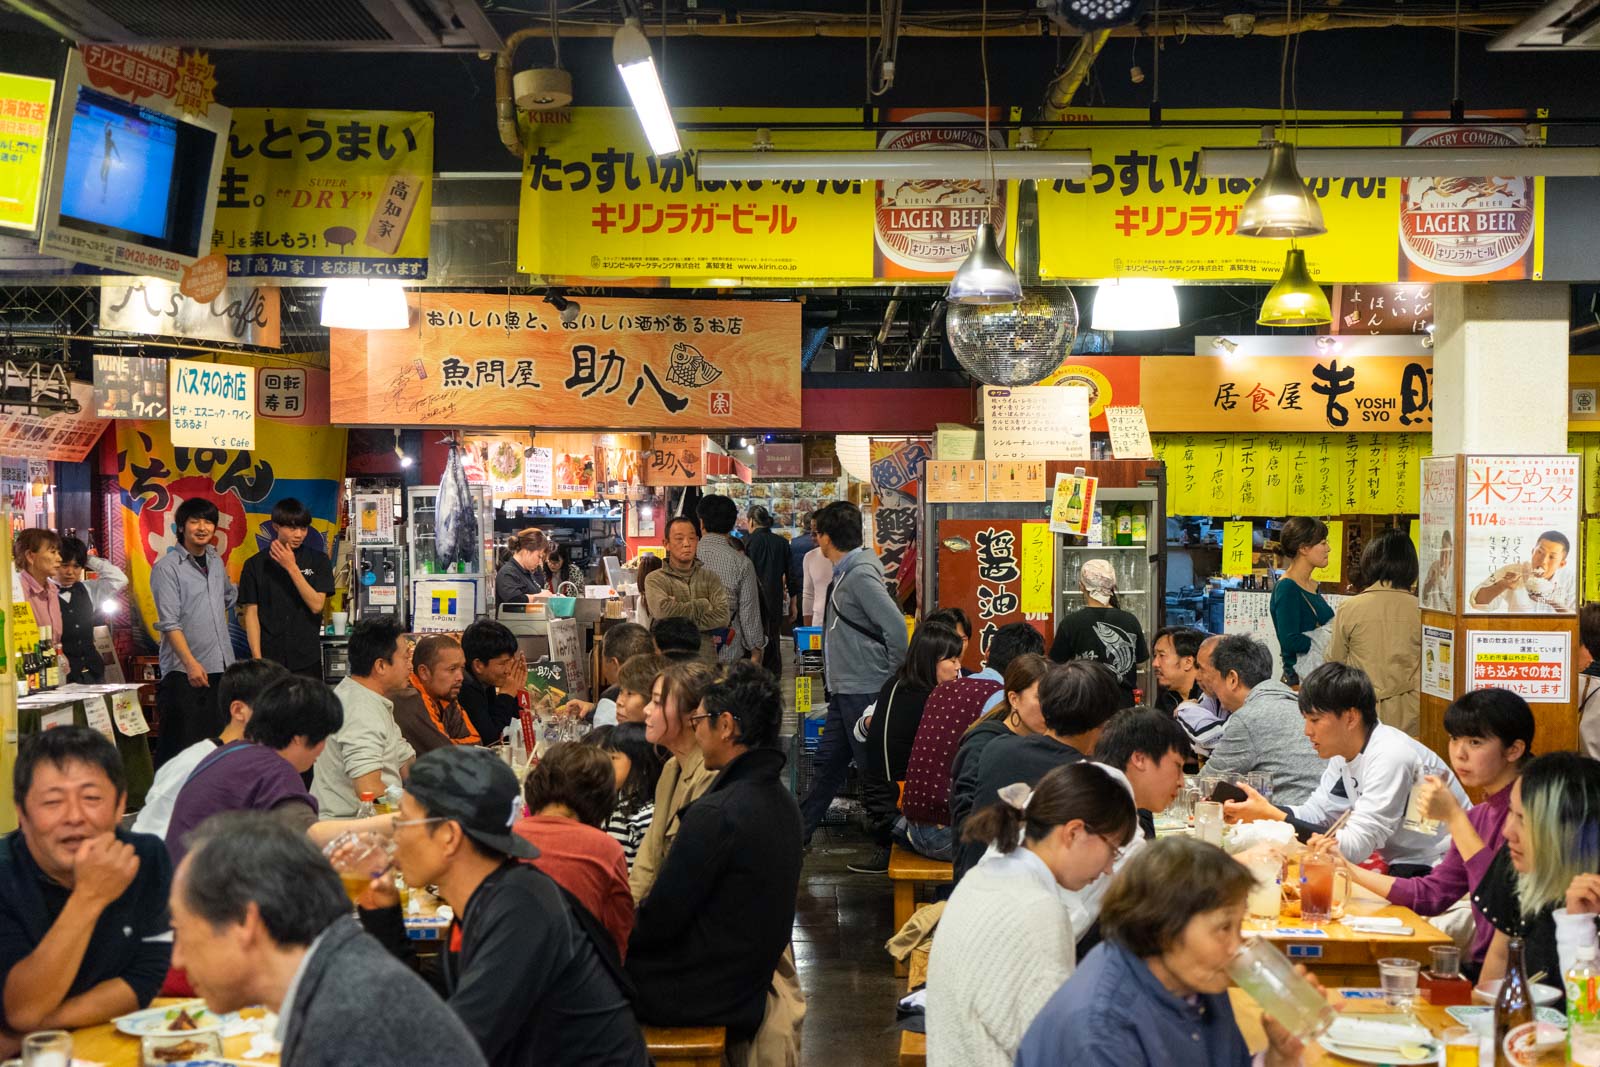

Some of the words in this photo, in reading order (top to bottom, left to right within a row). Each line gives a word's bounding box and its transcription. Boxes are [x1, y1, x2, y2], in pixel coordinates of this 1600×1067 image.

[89, 47, 170, 92] テレビ朝日系列
[528, 111, 571, 124] KIRIN
[308, 177, 347, 187] SUPER
[378, 180, 410, 239] 高知家
[592, 202, 798, 235] キリンラガービール
[891, 211, 944, 228] LAGER
[950, 210, 988, 227] BEER
[1415, 214, 1471, 233] LAGER
[1476, 212, 1516, 231] BEER
[126, 247, 180, 272] 0120-801-520
[706, 262, 733, 270] 高知支社
[737, 263, 798, 272] www.kirin.co.jp
[98, 357, 129, 376] WINE
[176, 367, 246, 400] パスタのお店
[265, 374, 300, 390] 回転
[442, 357, 541, 389] 魚問屋
[564, 345, 689, 414] 助八
[265, 396, 299, 412] 寿司
[1213, 382, 1303, 412] 居食屋
[1355, 398, 1396, 409] YOSHI
[132, 400, 167, 417] ワイン
[1362, 411, 1390, 422] SYO
[652, 450, 695, 478] 助八
[1468, 466, 1507, 505] 米
[1507, 467, 1543, 487] こめ
[1506, 484, 1574, 504] フェスタ
[1468, 512, 1498, 526] 11/4
[1475, 664, 1561, 679] 持ち込みでの飲食
